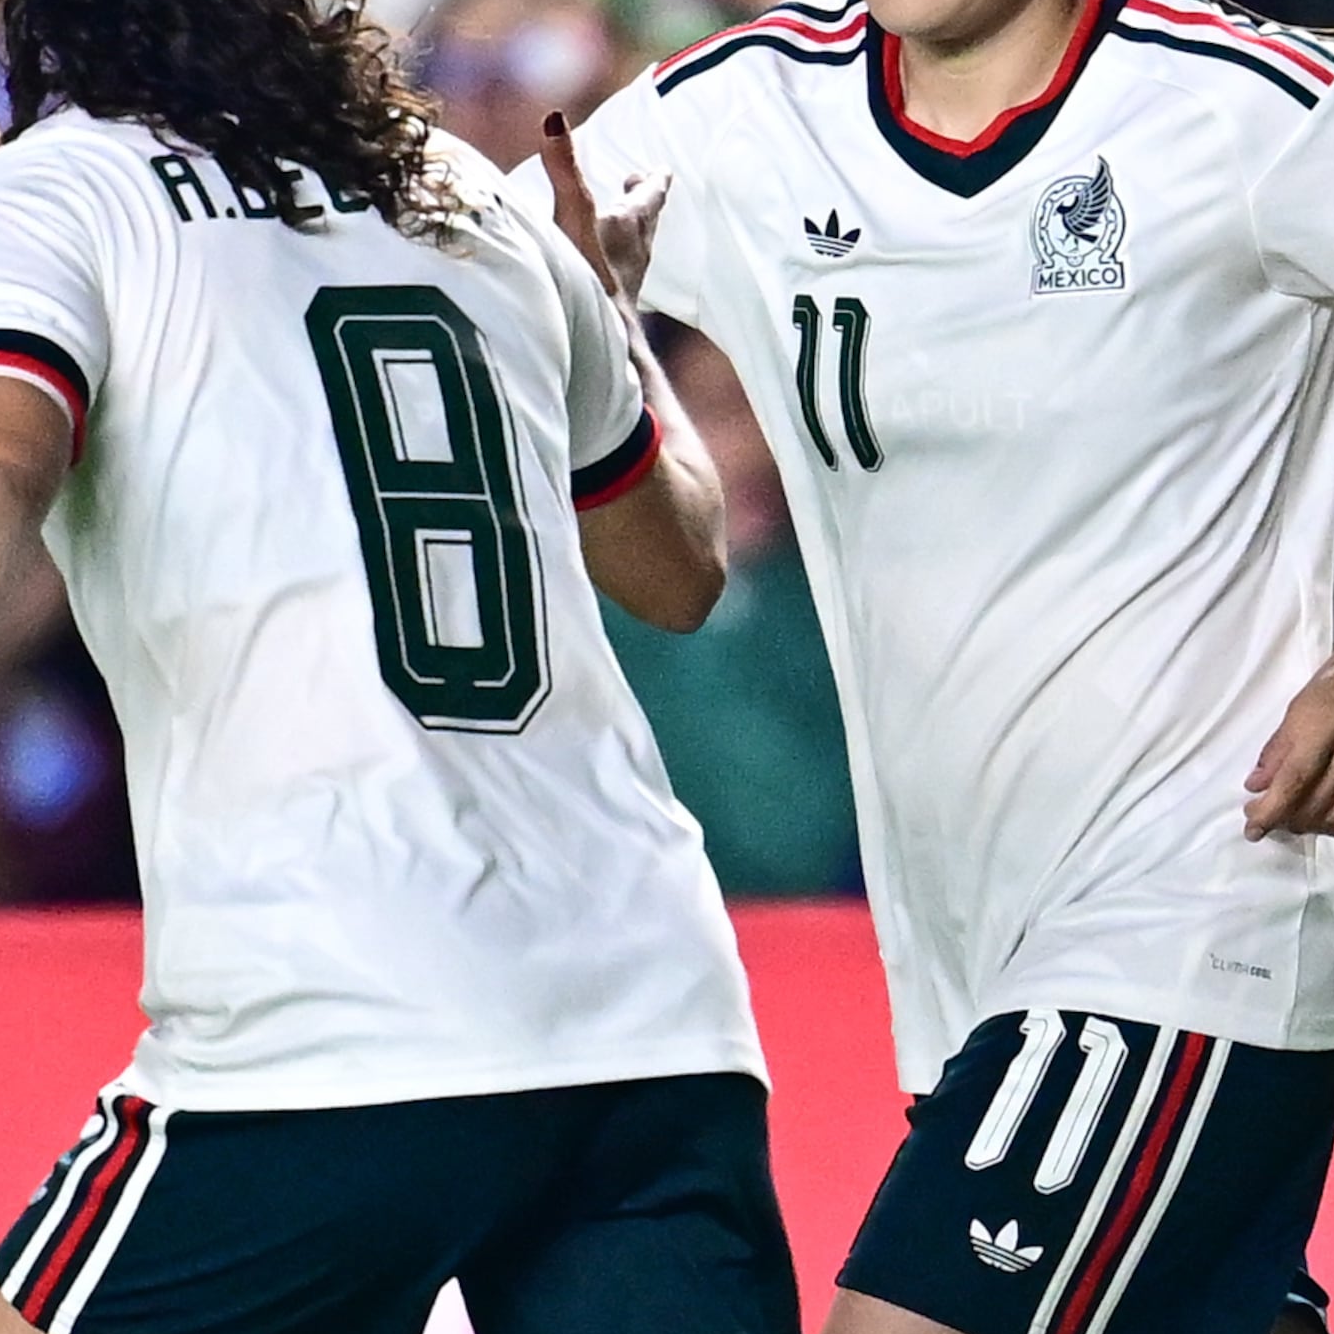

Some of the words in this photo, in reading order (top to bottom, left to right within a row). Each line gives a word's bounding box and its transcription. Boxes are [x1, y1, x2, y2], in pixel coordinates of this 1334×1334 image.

[792, 293, 885, 473] 11
[304, 285, 553, 735] 8
[964, 1008, 1130, 1195] 11
